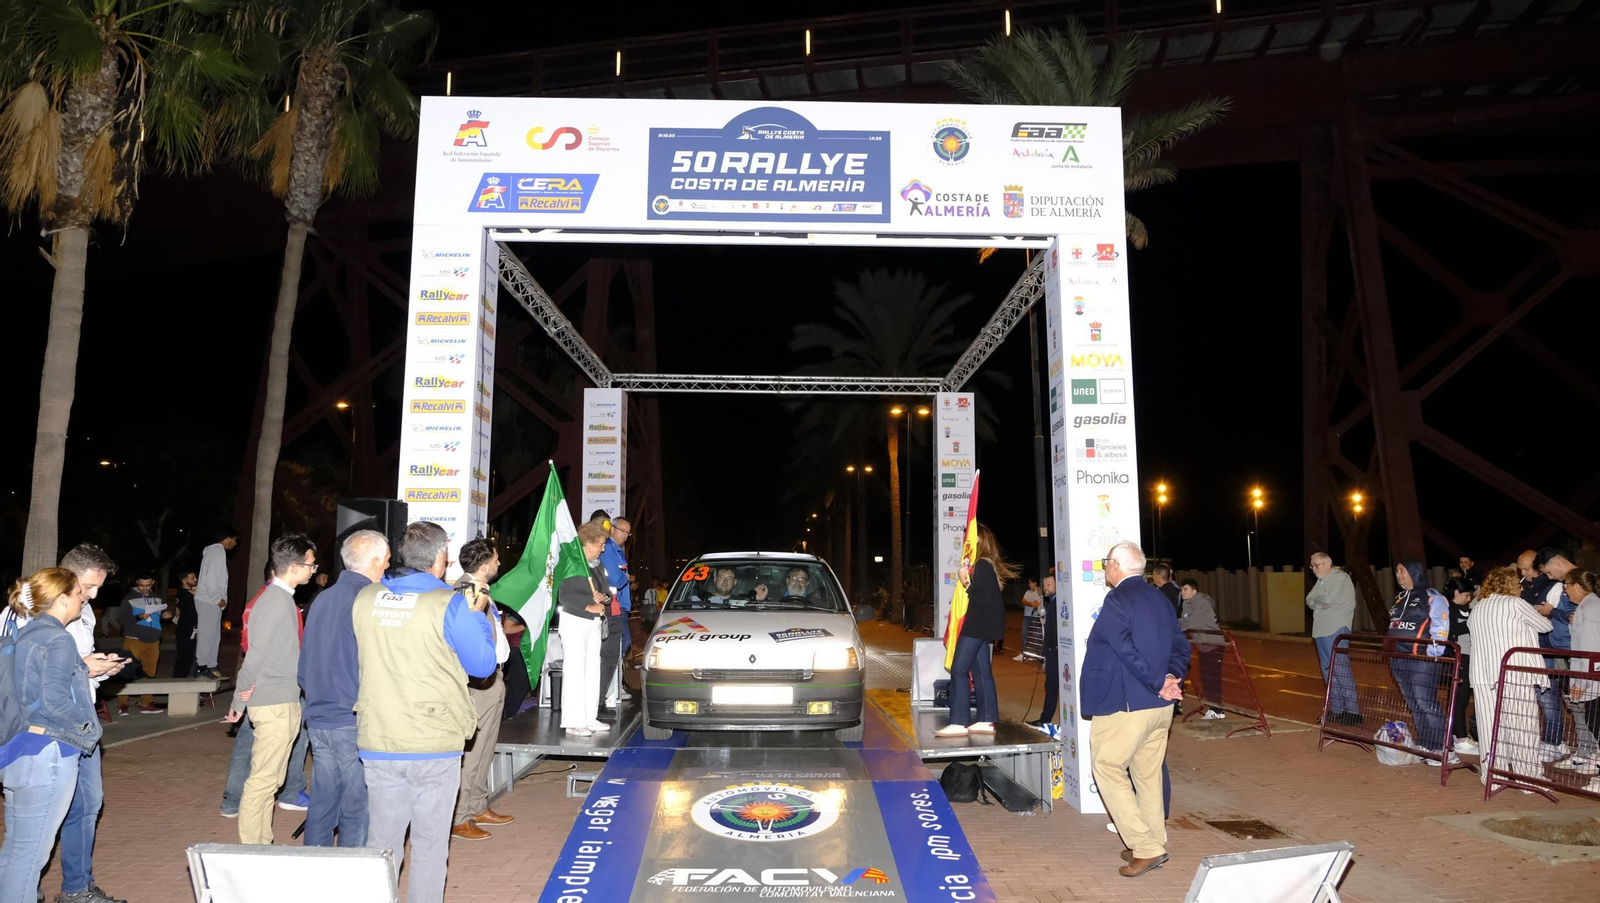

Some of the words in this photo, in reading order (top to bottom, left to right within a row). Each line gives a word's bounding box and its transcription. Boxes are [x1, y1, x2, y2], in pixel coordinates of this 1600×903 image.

[670, 150, 718, 173] 50
[720, 151, 869, 176] RALLYE
[517, 177, 583, 190] CERA
[670, 178, 738, 191] COSTA
[741, 179, 769, 191] DE
[772, 177, 866, 193] ALMERÍA
[529, 198, 570, 209] Recalvi
[935, 192, 973, 203] COSTA
[975, 193, 989, 203] DE
[1030, 195, 1104, 207] DIPUTACIÓN
[924, 201, 991, 217] ALMERÍA
[1030, 207, 1047, 217] DE
[1049, 205, 1102, 218] ALMERÍA
[420, 289, 469, 301] Rallycar
[425, 315, 460, 323] Recalvi
[1070, 353, 1125, 368] MOYA
[415, 377, 465, 388] Rallycar
[421, 402, 455, 411] Recalvi
[1073, 412, 1127, 428] gasolia
[1096, 443, 1127, 451] Fornieles
[1103, 450, 1128, 458] albesa
[941, 459, 971, 467] MOYA
[409, 464, 460, 477] Rallycar
[1076, 469, 1128, 485] Phonika
[415, 491, 450, 500] Recalvi
[942, 492, 971, 501] gasolia
[681, 566, 710, 582] 63
[656, 632, 695, 644] apdi
[698, 633, 752, 642] group
[723, 830, 807, 840] ALMERIA
[650, 868, 889, 887] FACV
[671, 885, 741, 893] FEDERACIÓN
[758, 890, 825, 898] COMUNITAT
